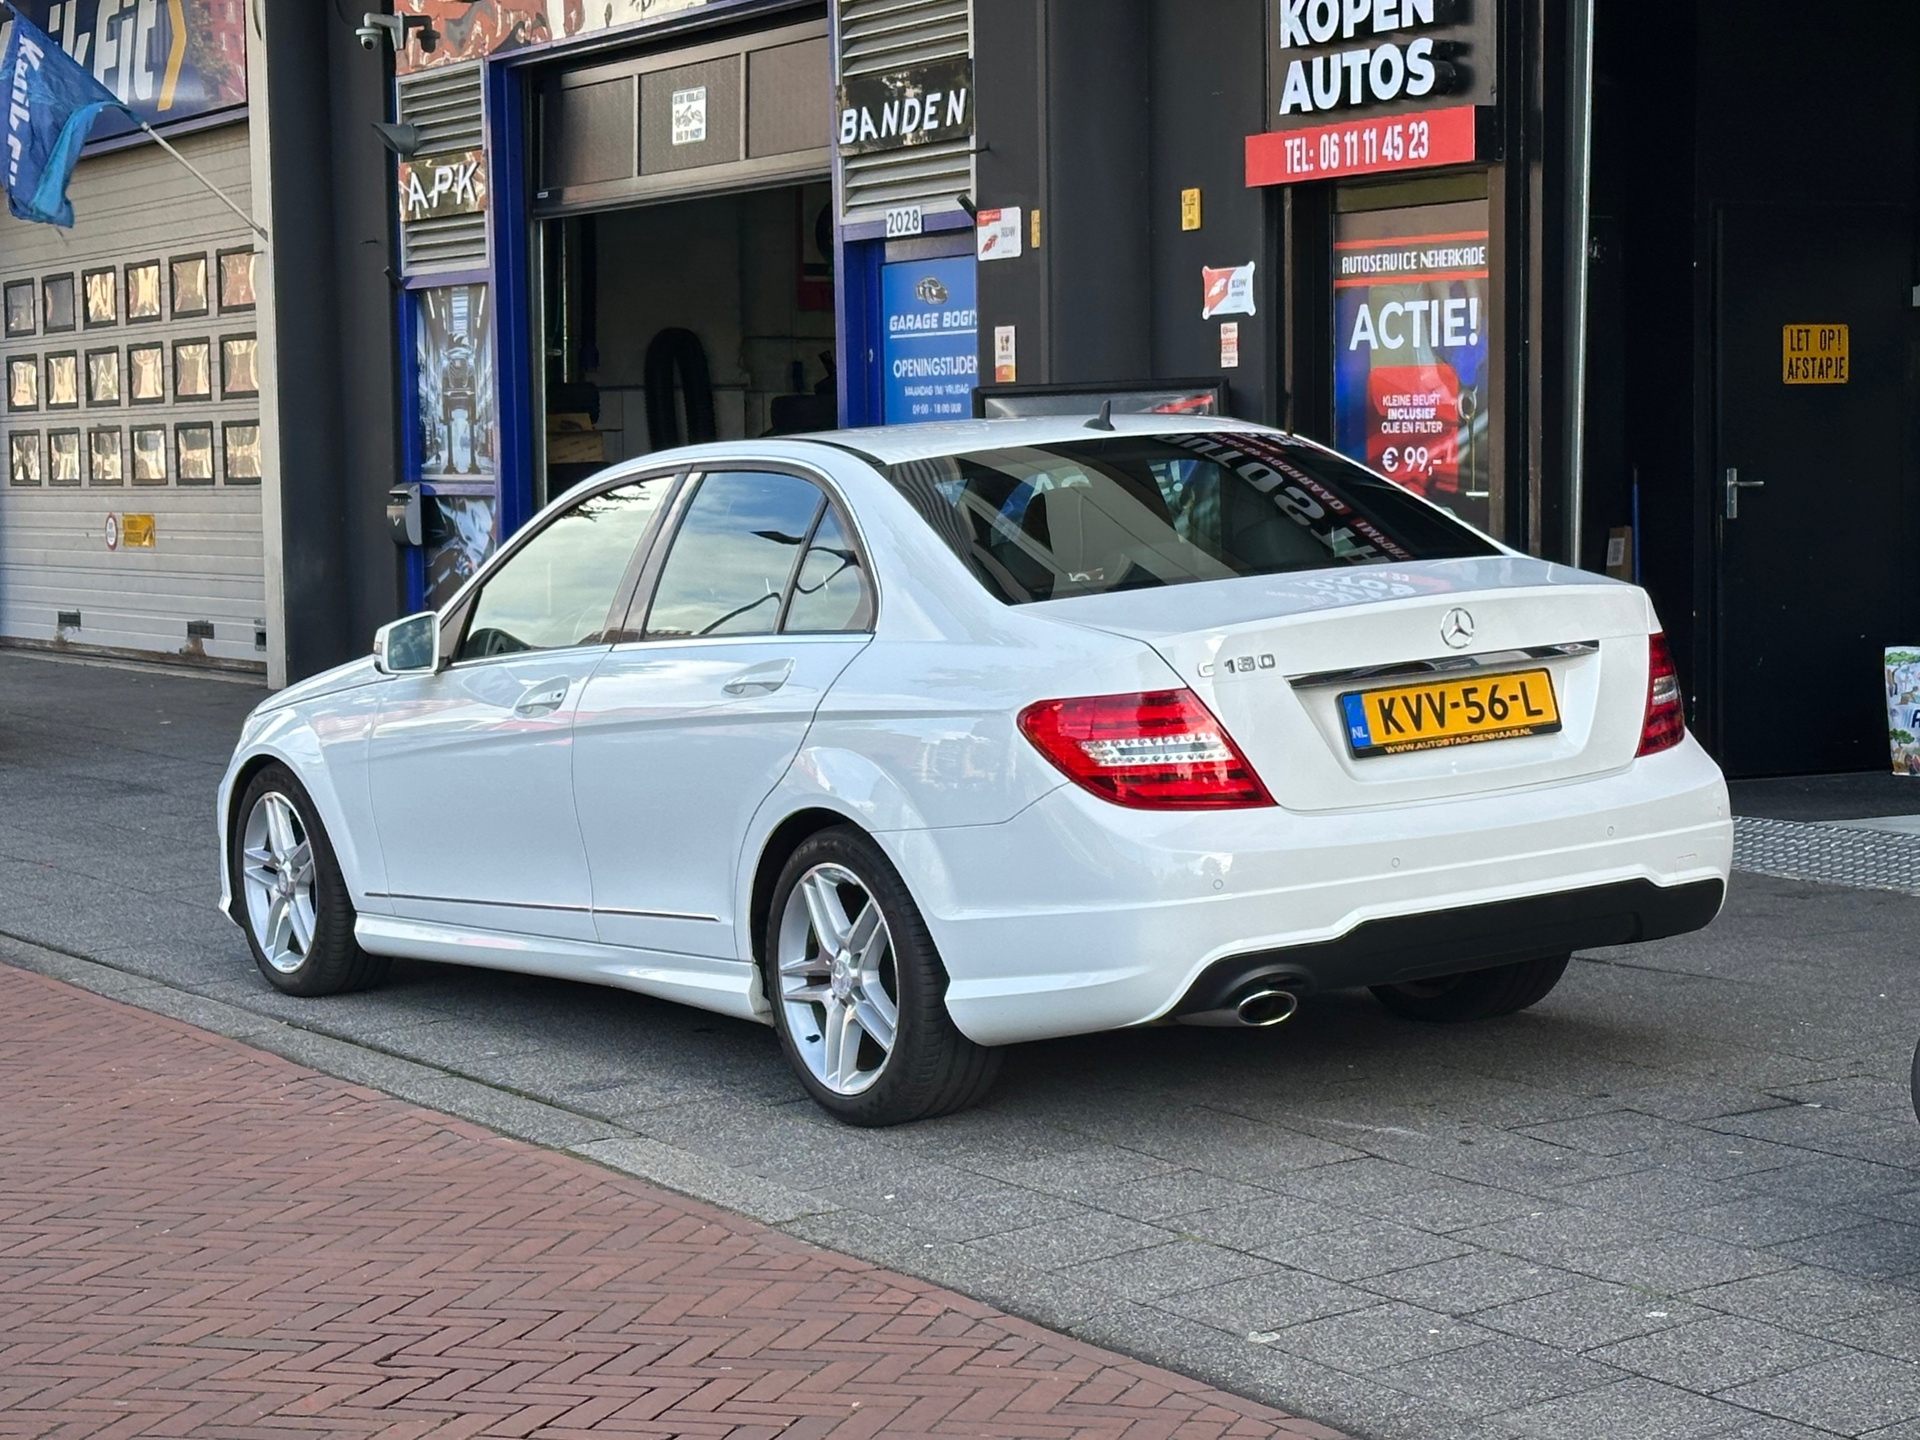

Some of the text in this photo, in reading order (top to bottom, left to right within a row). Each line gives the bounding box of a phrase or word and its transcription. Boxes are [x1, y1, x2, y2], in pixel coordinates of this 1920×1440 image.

[1279, 0, 1434, 49] KOPEN
[1279, 37, 1435, 115] AUTOS
[840, 88, 967, 144] BANDEN
[1285, 120, 1429, 173] TEL: 06 11 11 45 23
[408, 162, 477, 211] APK
[887, 209, 920, 234] 2028
[1342, 246, 1485, 274] AUTOSERVICE NEHERKADE
[889, 312, 939, 331] GARAGE
[1349, 297, 1478, 350] ACTIE!
[1789, 328, 1842, 351] LET OP!
[893, 355, 978, 378] OPENINGSTIJDEN
[1787, 356, 1845, 379] AFSTAPJE
[1382, 393, 1441, 406] KLEINE BEURT
[1387, 407, 1436, 420] INCLUSIEF
[1381, 421, 1443, 434] OLIE EN FILTER
[1382, 446, 1442, 476] € 99,-
[1223, 653, 1276, 674] 180
[1377, 680, 1544, 736] KVV-56-L
[1352, 726, 1369, 739] NL
